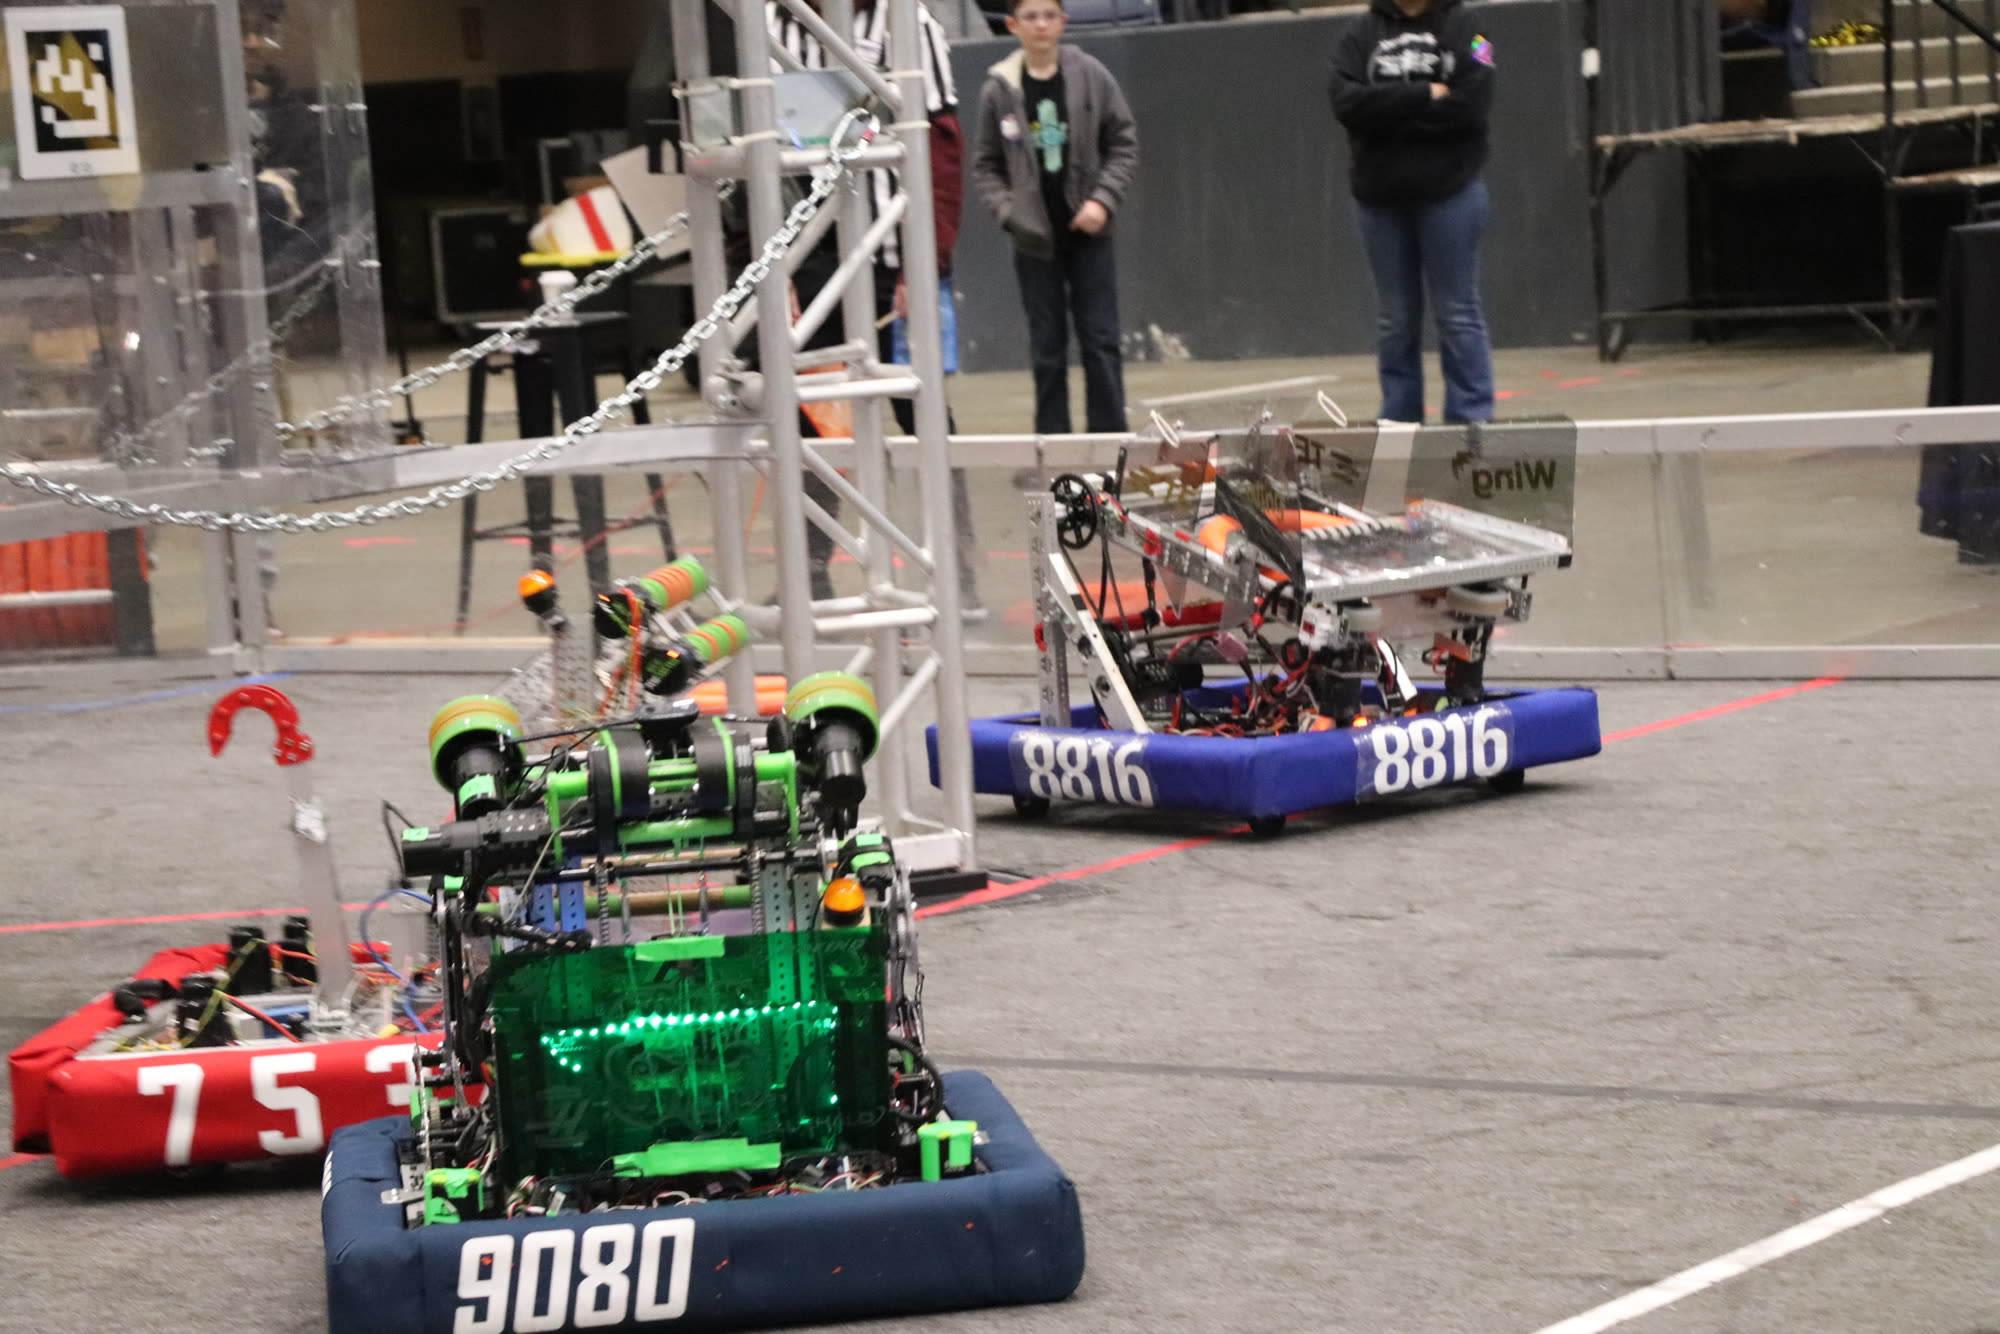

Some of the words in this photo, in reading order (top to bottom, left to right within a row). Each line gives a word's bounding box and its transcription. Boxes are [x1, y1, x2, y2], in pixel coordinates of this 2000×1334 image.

[1022, 733, 1154, 808] 8816
[1371, 706, 1508, 795] 8816
[453, 1217, 696, 1334] 9080
